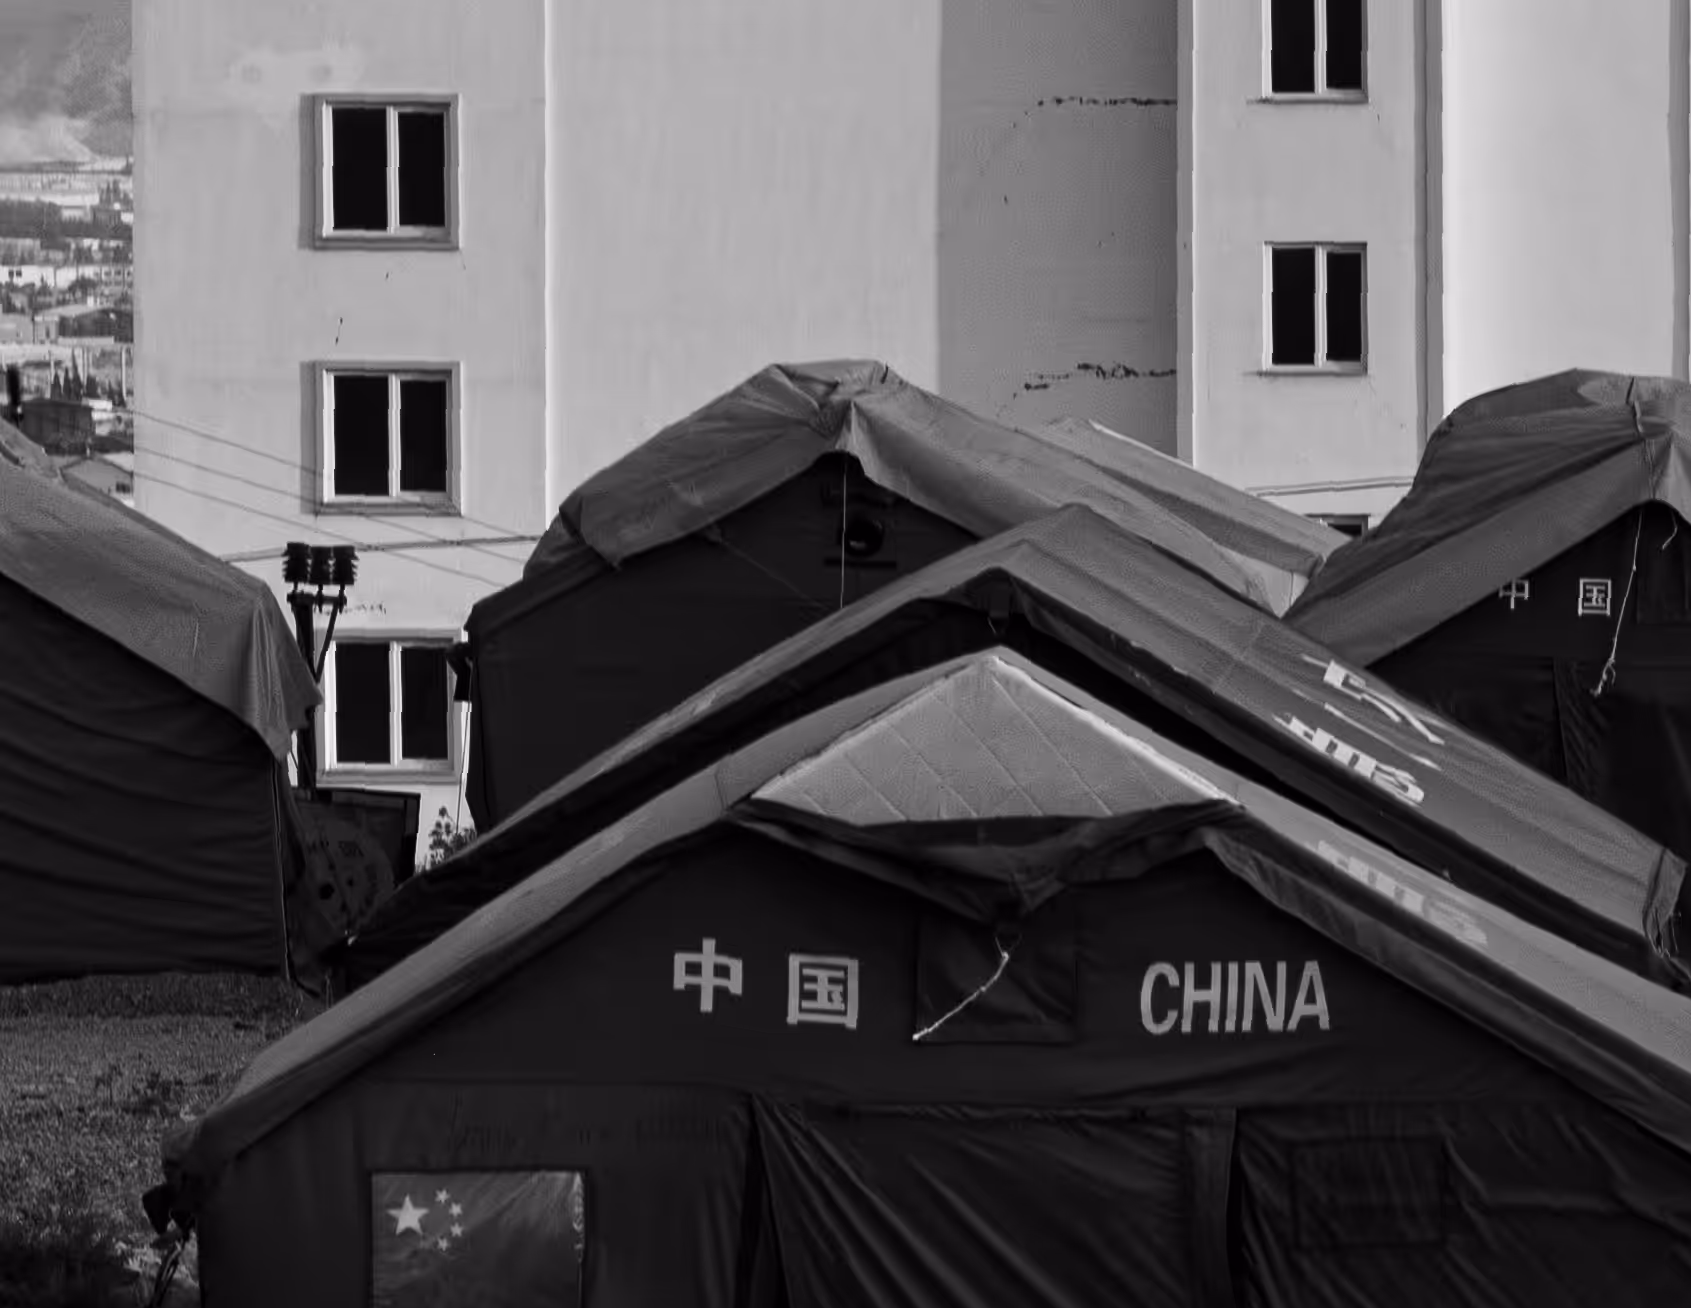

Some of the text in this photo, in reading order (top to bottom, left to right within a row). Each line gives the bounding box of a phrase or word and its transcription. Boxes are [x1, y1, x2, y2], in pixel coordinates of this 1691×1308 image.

[1497, 577, 1613, 617] 中国
[673, 938, 1330, 1035] 中国 CHINA
